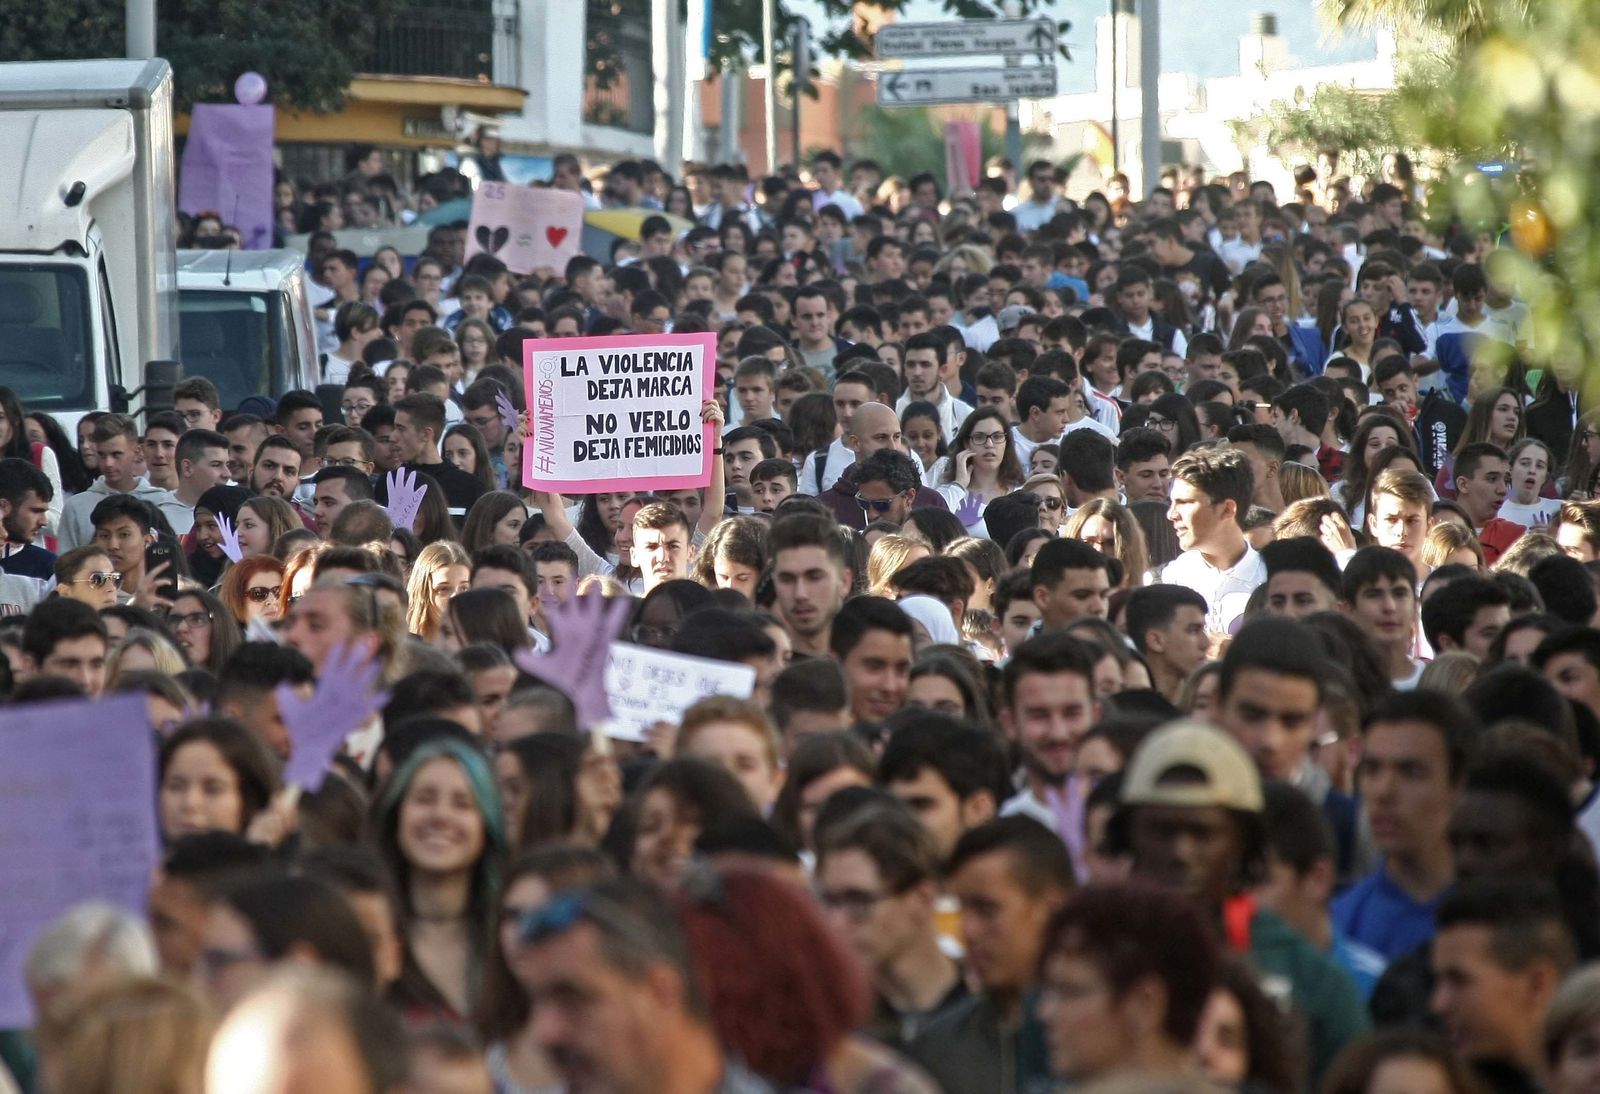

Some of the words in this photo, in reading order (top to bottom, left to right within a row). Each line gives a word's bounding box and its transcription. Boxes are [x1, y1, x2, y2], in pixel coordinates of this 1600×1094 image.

[560, 355, 589, 377] LA
[598, 351, 693, 375] VIOLENCIA
[587, 378, 633, 400] DEJA
[637, 375, 692, 398] MARCA
[586, 413, 617, 435] NO
[629, 409, 691, 433] VERLO
[573, 437, 620, 462] DEJA
[624, 434, 702, 458] FEMICIDIOS
